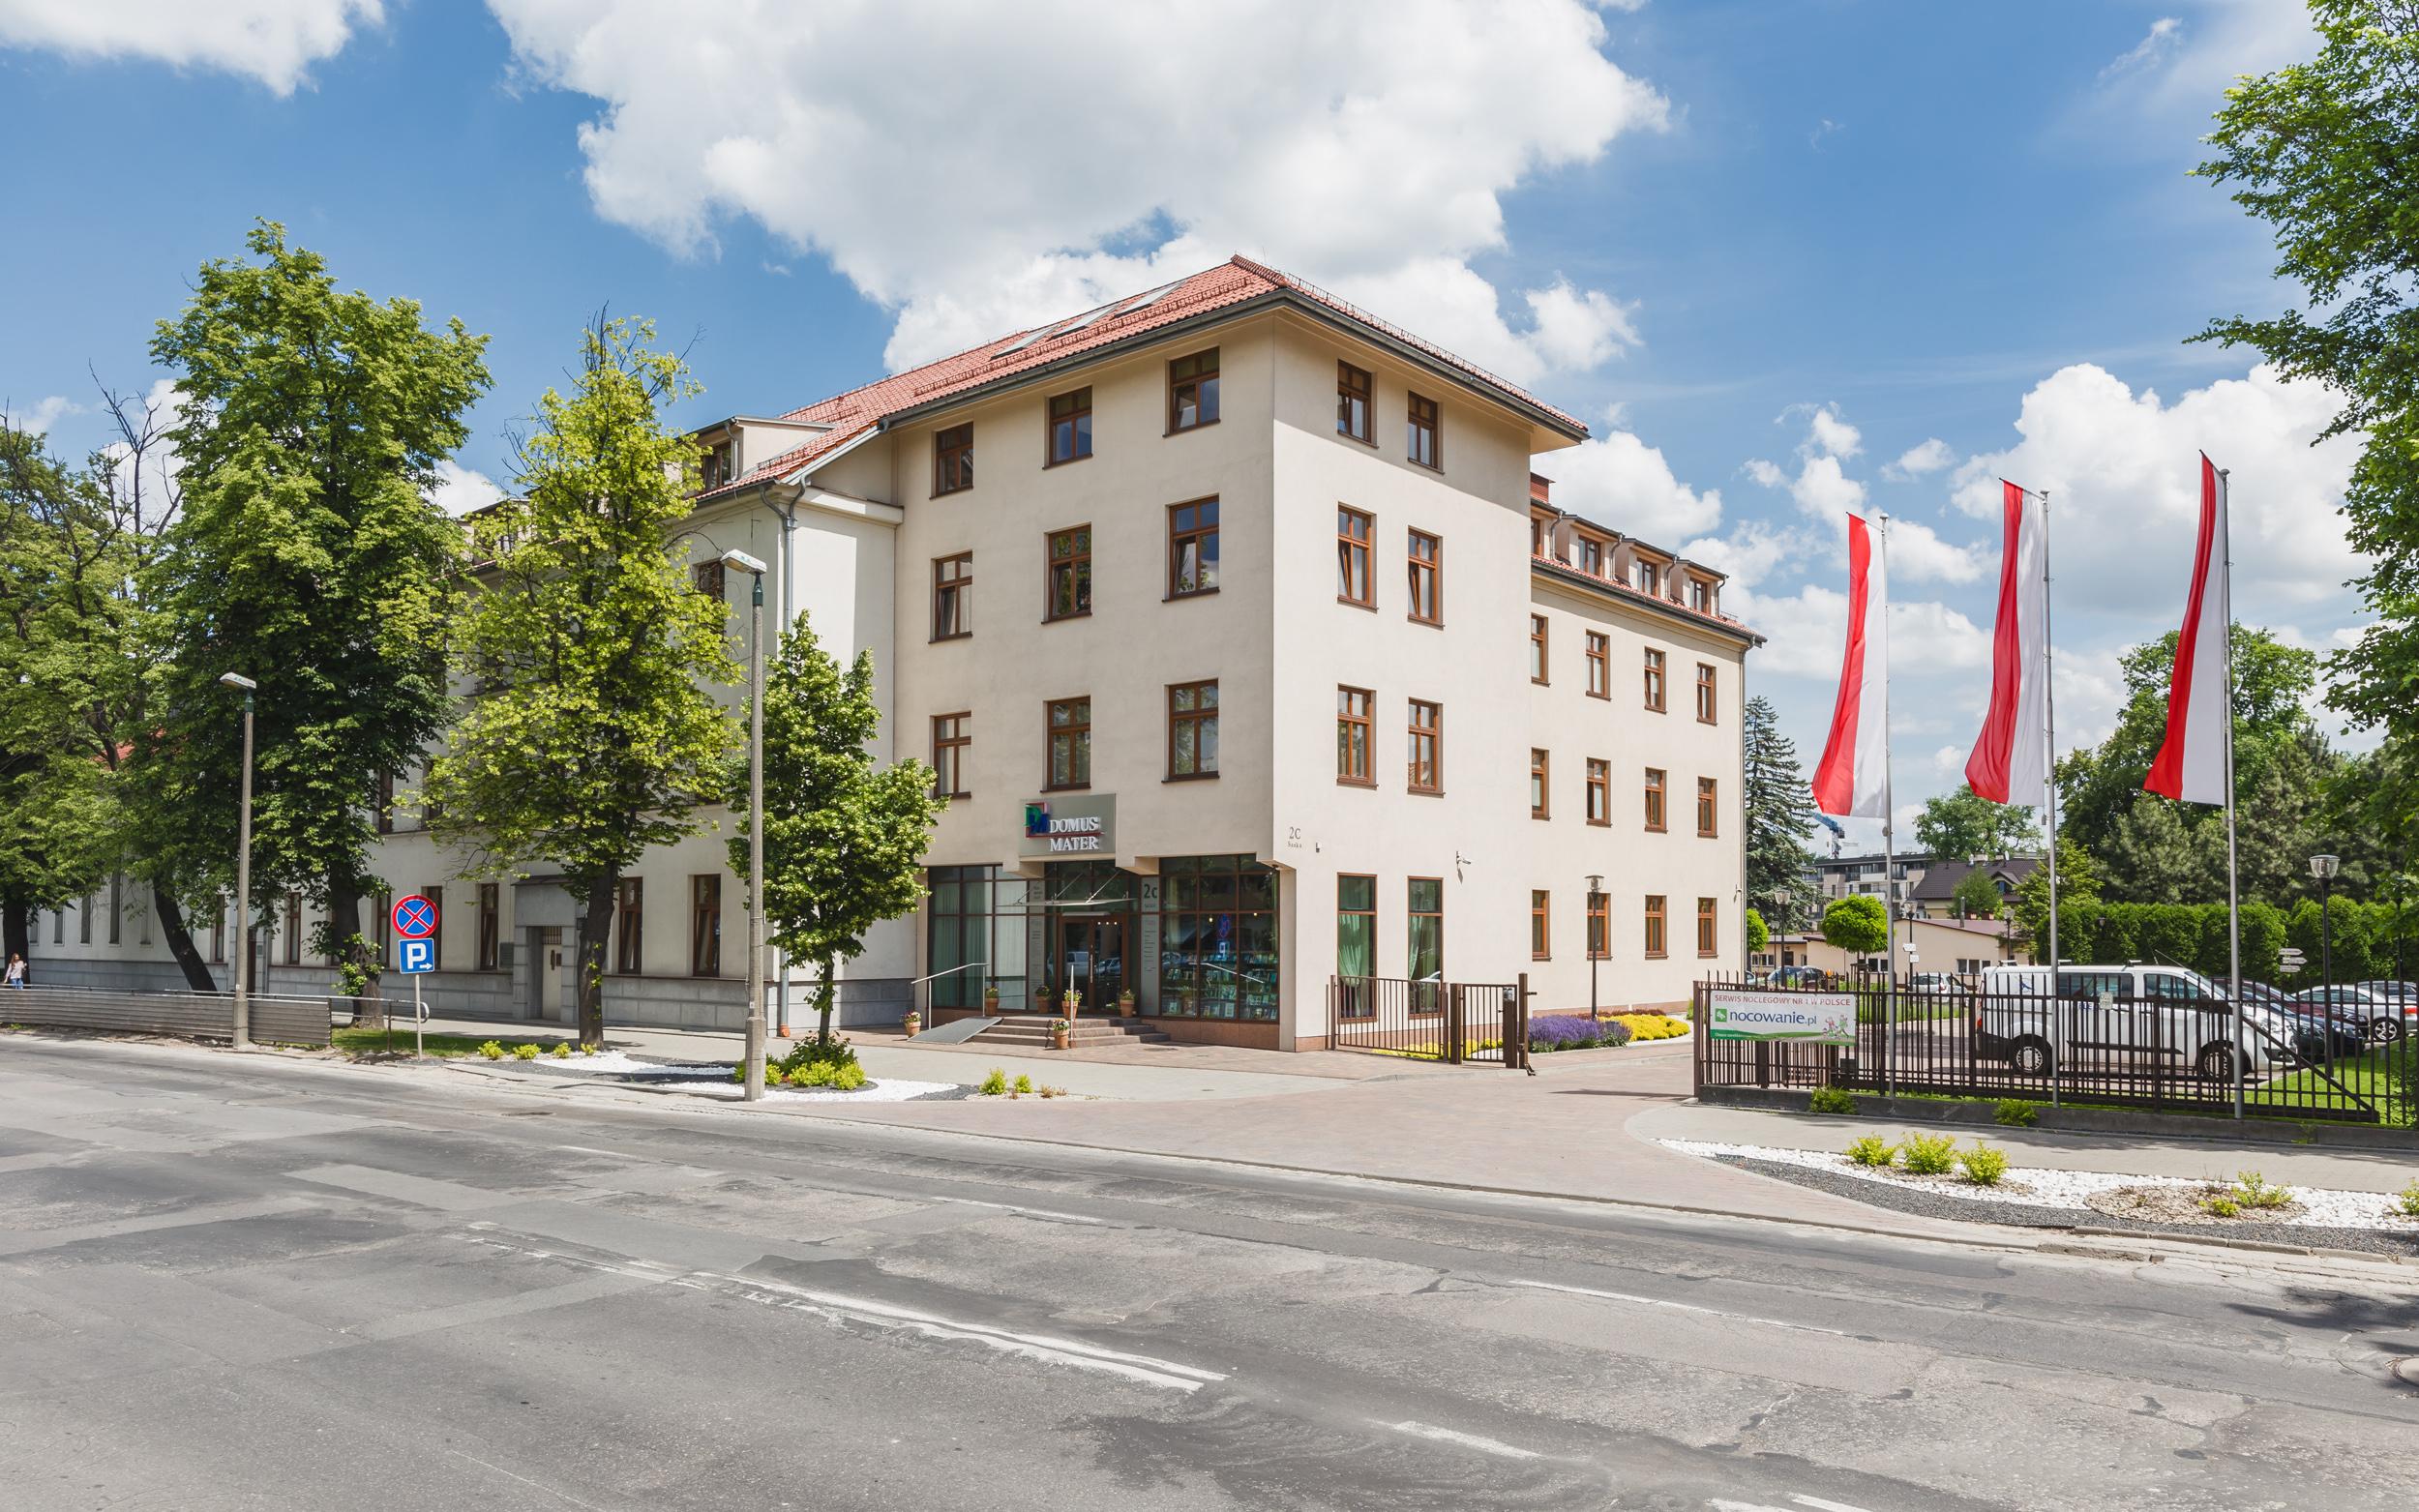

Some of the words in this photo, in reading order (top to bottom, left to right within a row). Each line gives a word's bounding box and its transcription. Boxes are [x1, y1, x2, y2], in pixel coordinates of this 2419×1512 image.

[1050, 816, 1100, 833] DOMUS
[1050, 836, 1100, 852] MATER
[407, 943, 427, 969] P
[1715, 994, 1742, 1003] SERWIS
[1743, 996, 1791, 1005] NOCLEGOWY
[1730, 1011, 1817, 1026] nocowanie.pl
